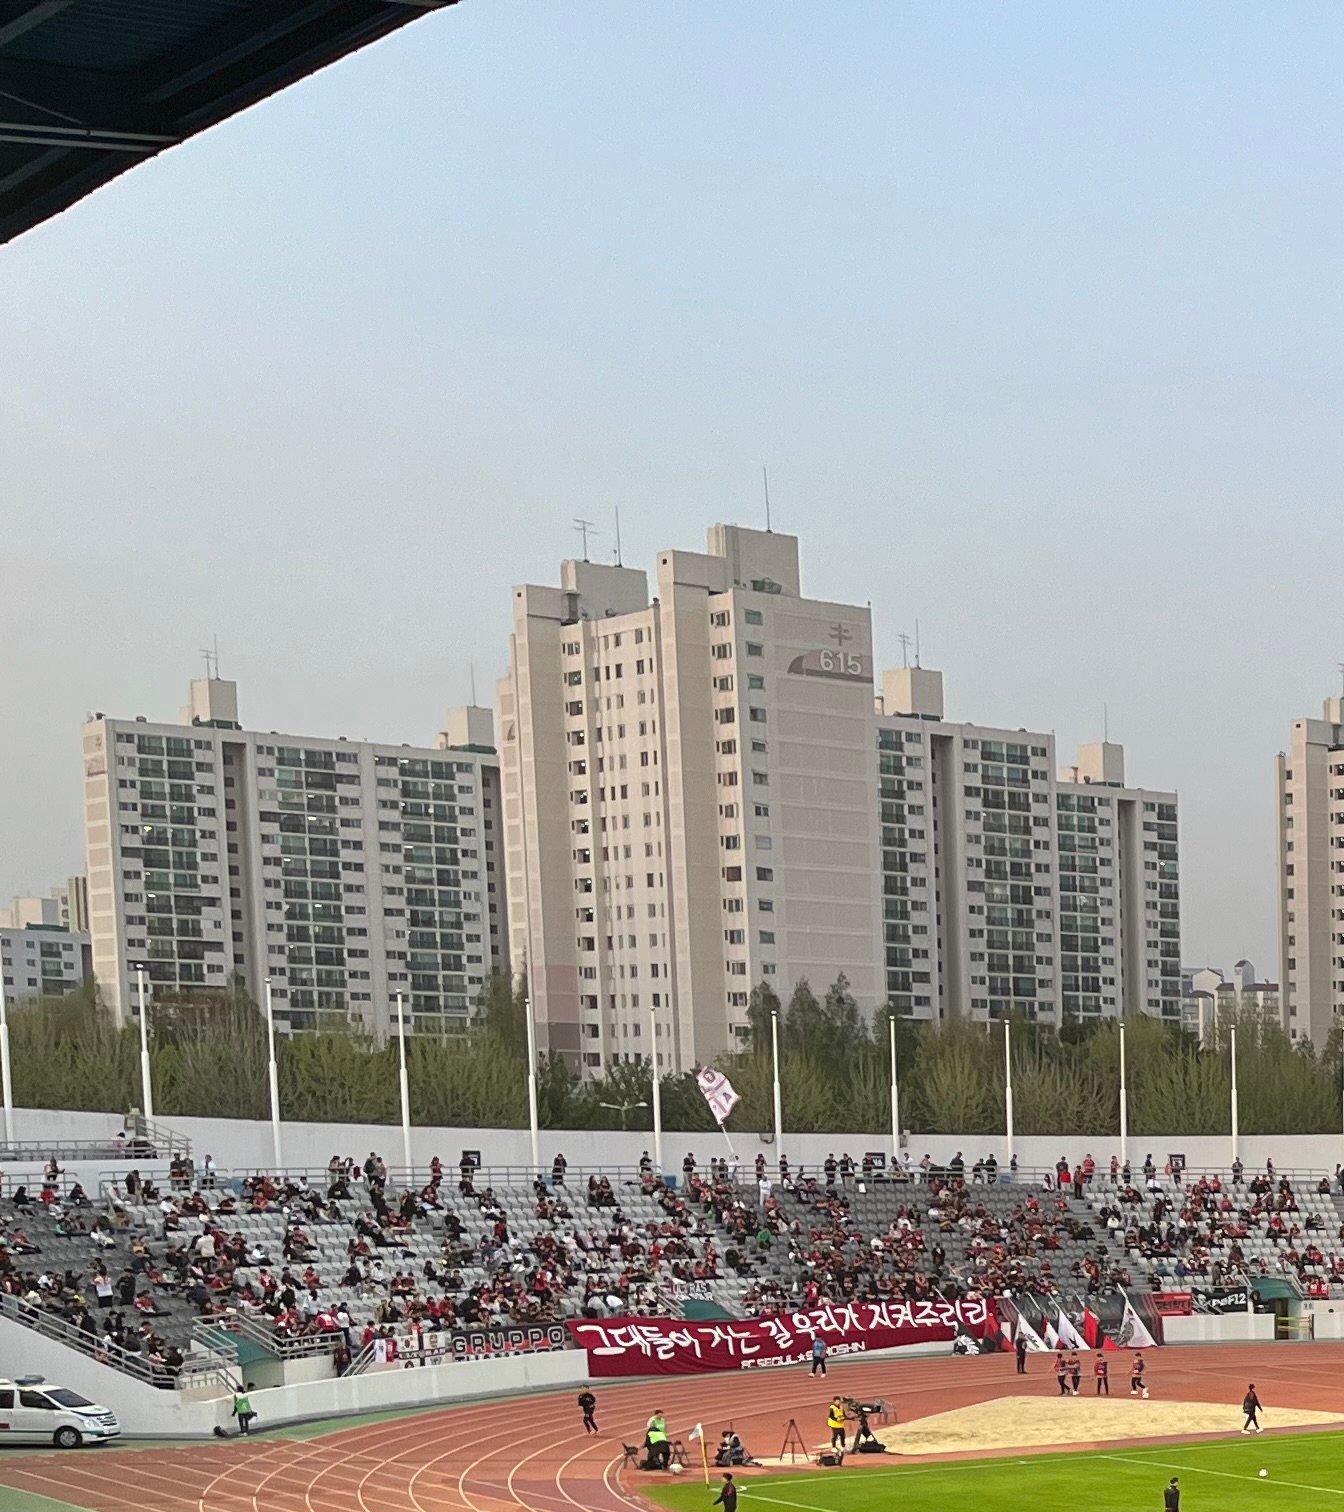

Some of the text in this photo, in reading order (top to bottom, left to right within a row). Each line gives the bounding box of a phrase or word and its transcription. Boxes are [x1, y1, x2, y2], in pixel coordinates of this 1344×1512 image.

[820, 649, 863, 675] 615
[452, 1325, 565, 1354] GRUPPO
[576, 1324, 702, 1360] 그대들이
[759, 1317, 794, 1349] 길
[792, 1303, 867, 1341] 우리가
[740, 1359, 757, 1370] FC
